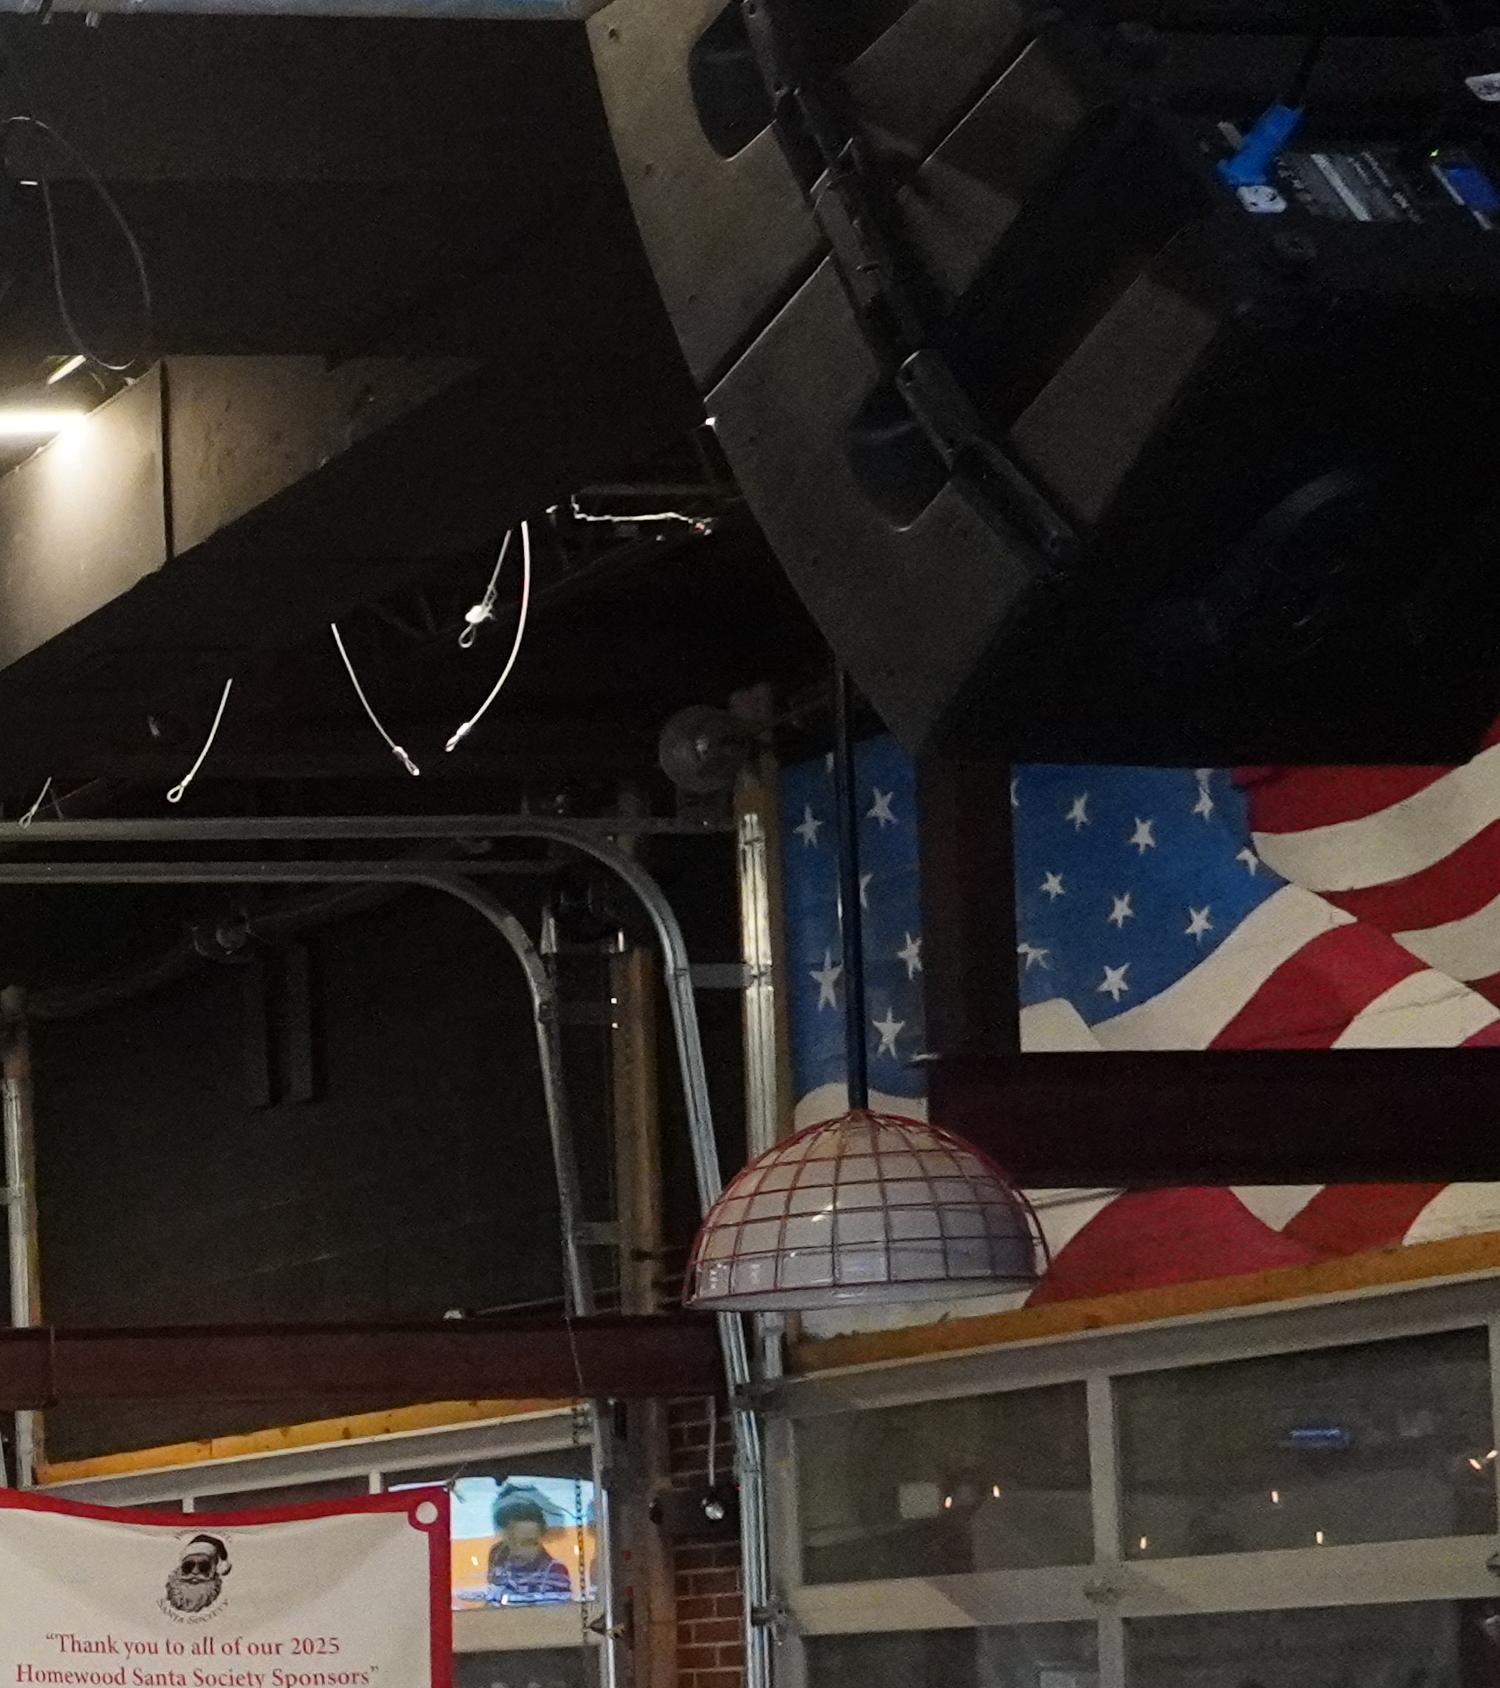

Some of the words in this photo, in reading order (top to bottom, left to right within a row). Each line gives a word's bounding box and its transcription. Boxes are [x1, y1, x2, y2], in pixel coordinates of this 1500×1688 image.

[123, 1639, 160, 1660] you
[165, 1638, 186, 1656] to
[191, 1636, 215, 1656] all
[221, 1636, 244, 1656] of
[246, 1641, 284, 1656] our
[290, 1637, 341, 1656] 2025
[15, 1663, 127, 1686] Homewood
[132, 1667, 188, 1687] Santa
